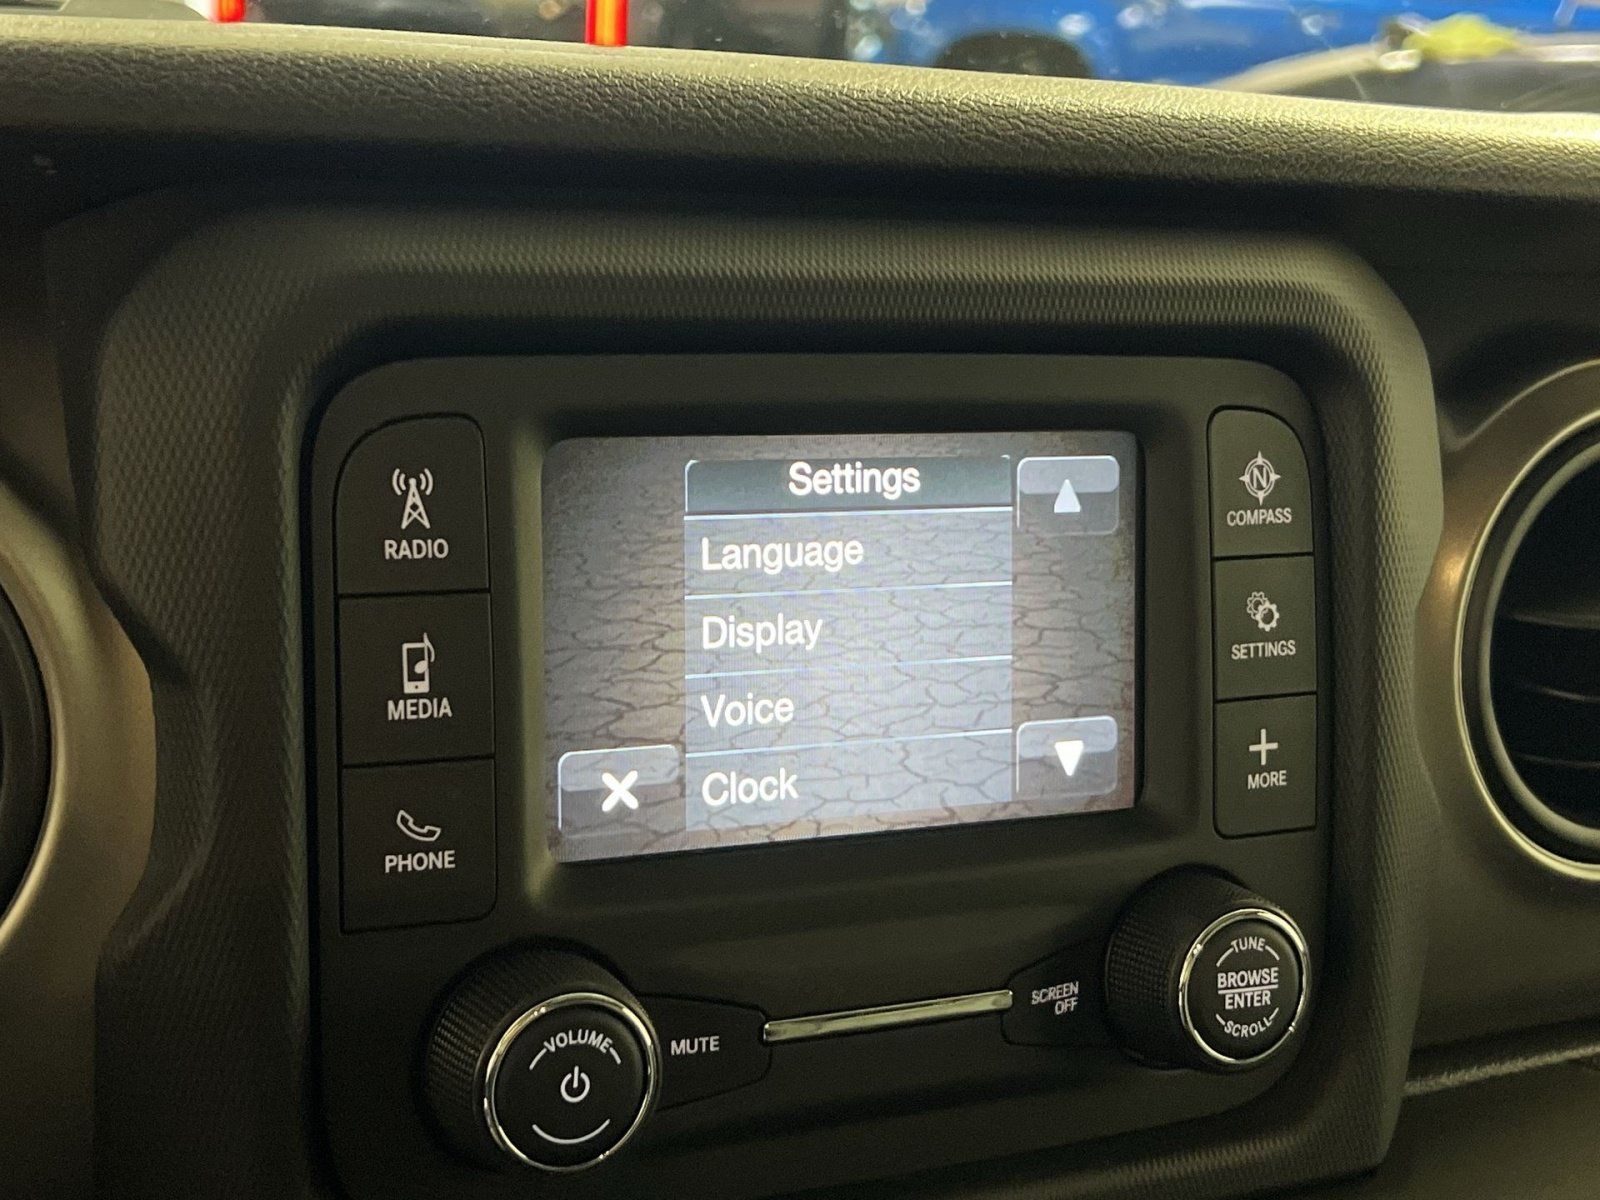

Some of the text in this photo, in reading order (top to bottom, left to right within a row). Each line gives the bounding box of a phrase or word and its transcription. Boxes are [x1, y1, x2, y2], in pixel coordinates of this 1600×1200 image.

[788, 461, 920, 500] Settings
[1226, 508, 1293, 527] COMPASS
[384, 539, 449, 560] RADIO
[701, 537, 864, 575] Language
[702, 613, 823, 653] Display
[1231, 640, 1296, 660] SETTINGS
[387, 697, 452, 721] MEDIA
[700, 692, 794, 728] Voice
[701, 768, 799, 807] Clock
[1247, 770, 1288, 790] MORE
[384, 850, 456, 873] PHONE
[1230, 936, 1266, 952] TUNE
[1217, 967, 1279, 989] BROWSE
[1031, 981, 1079, 1005] SCREEN
[1224, 991, 1271, 1010] ENTER
[1054, 998, 1078, 1016] OFF
[1223, 1016, 1272, 1038] SCROLL
[543, 1029, 613, 1054] VOLUME
[670, 1035, 720, 1056] MUTE
